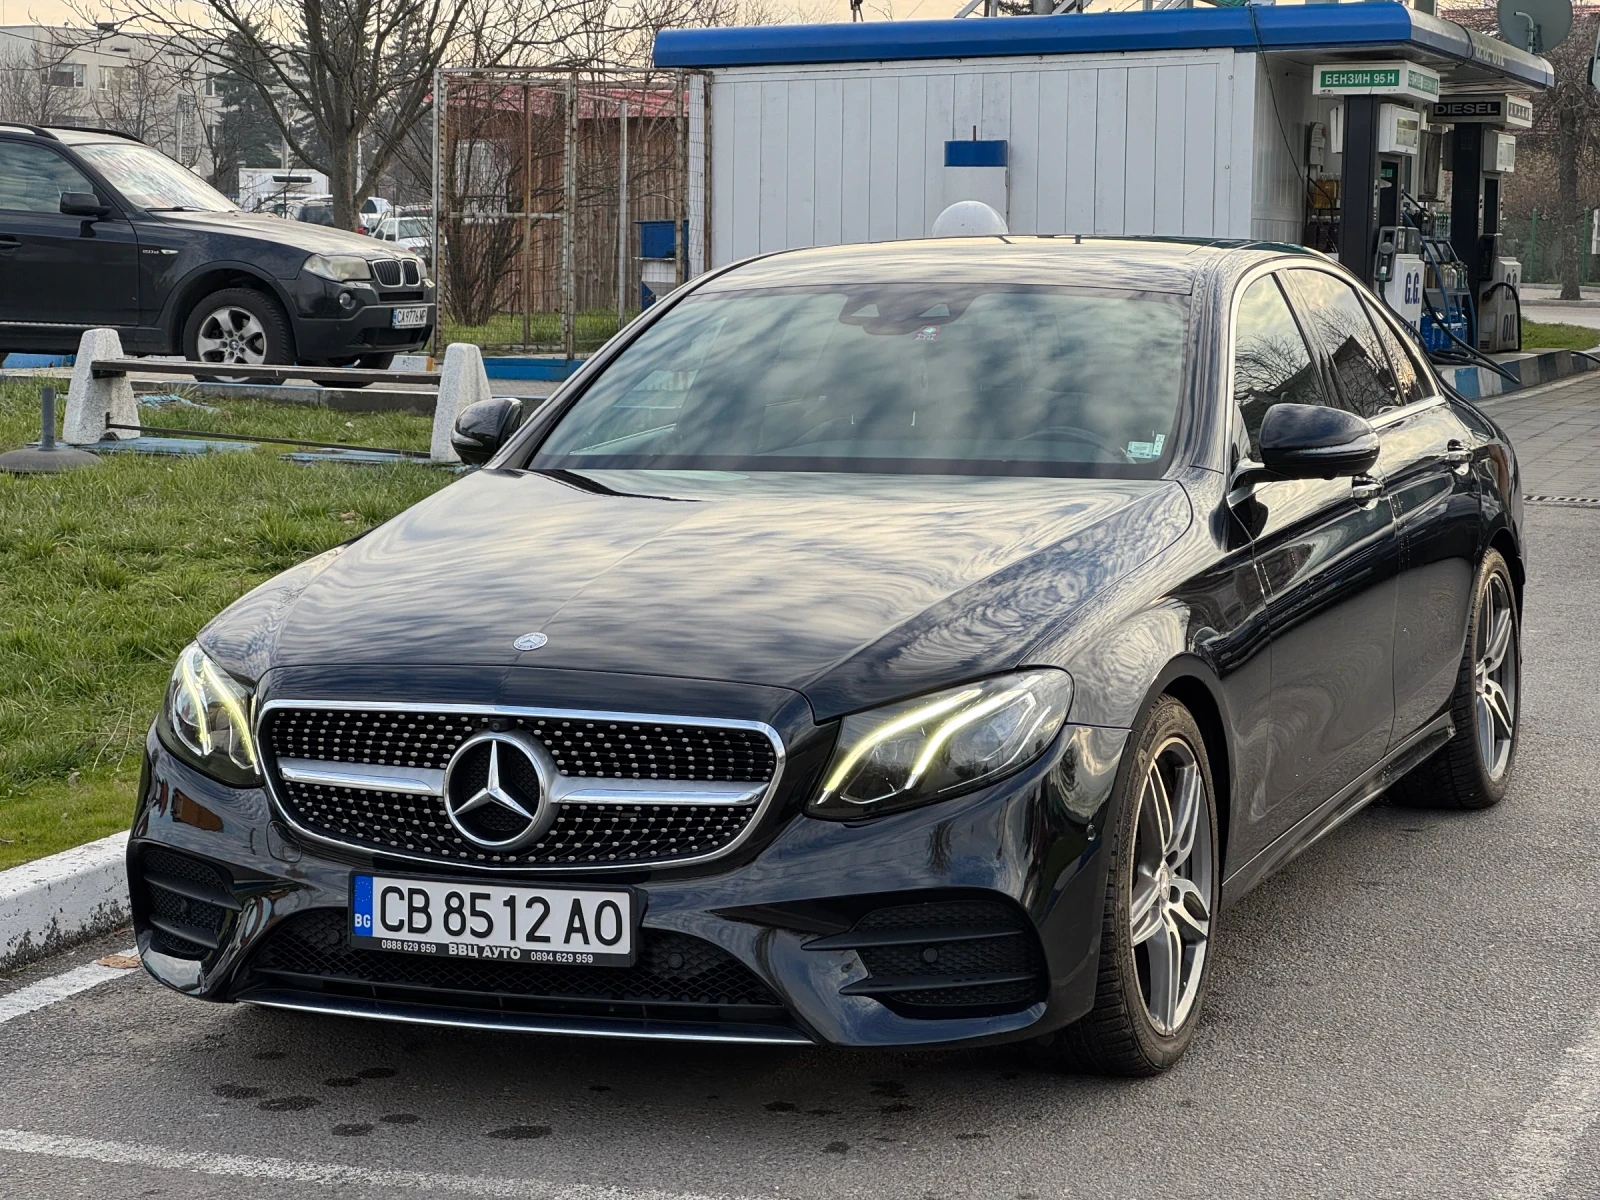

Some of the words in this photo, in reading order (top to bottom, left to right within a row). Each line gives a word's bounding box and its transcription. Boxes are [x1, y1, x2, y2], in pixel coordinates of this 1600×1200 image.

[1325, 73, 1371, 85] БЕНЗИН
[1434, 103, 1498, 115] DIESEL
[1405, 272, 1420, 305] G.G.
[1502, 314, 1516, 342] OIL
[354, 913, 371, 929] BG
[380, 885, 433, 935] CB
[443, 890, 551, 944] 8512
[563, 898, 623, 947] AO
[381, 939, 402, 950] 0888
[403, 942, 419, 952] 629
[420, 943, 437, 953] 959
[448, 943, 479, 959] ВВЦ
[482, 946, 521, 960] АУТО
[530, 951, 554, 962] 0894
[555, 952, 574, 963] 629
[575, 953, 594, 964] 959
